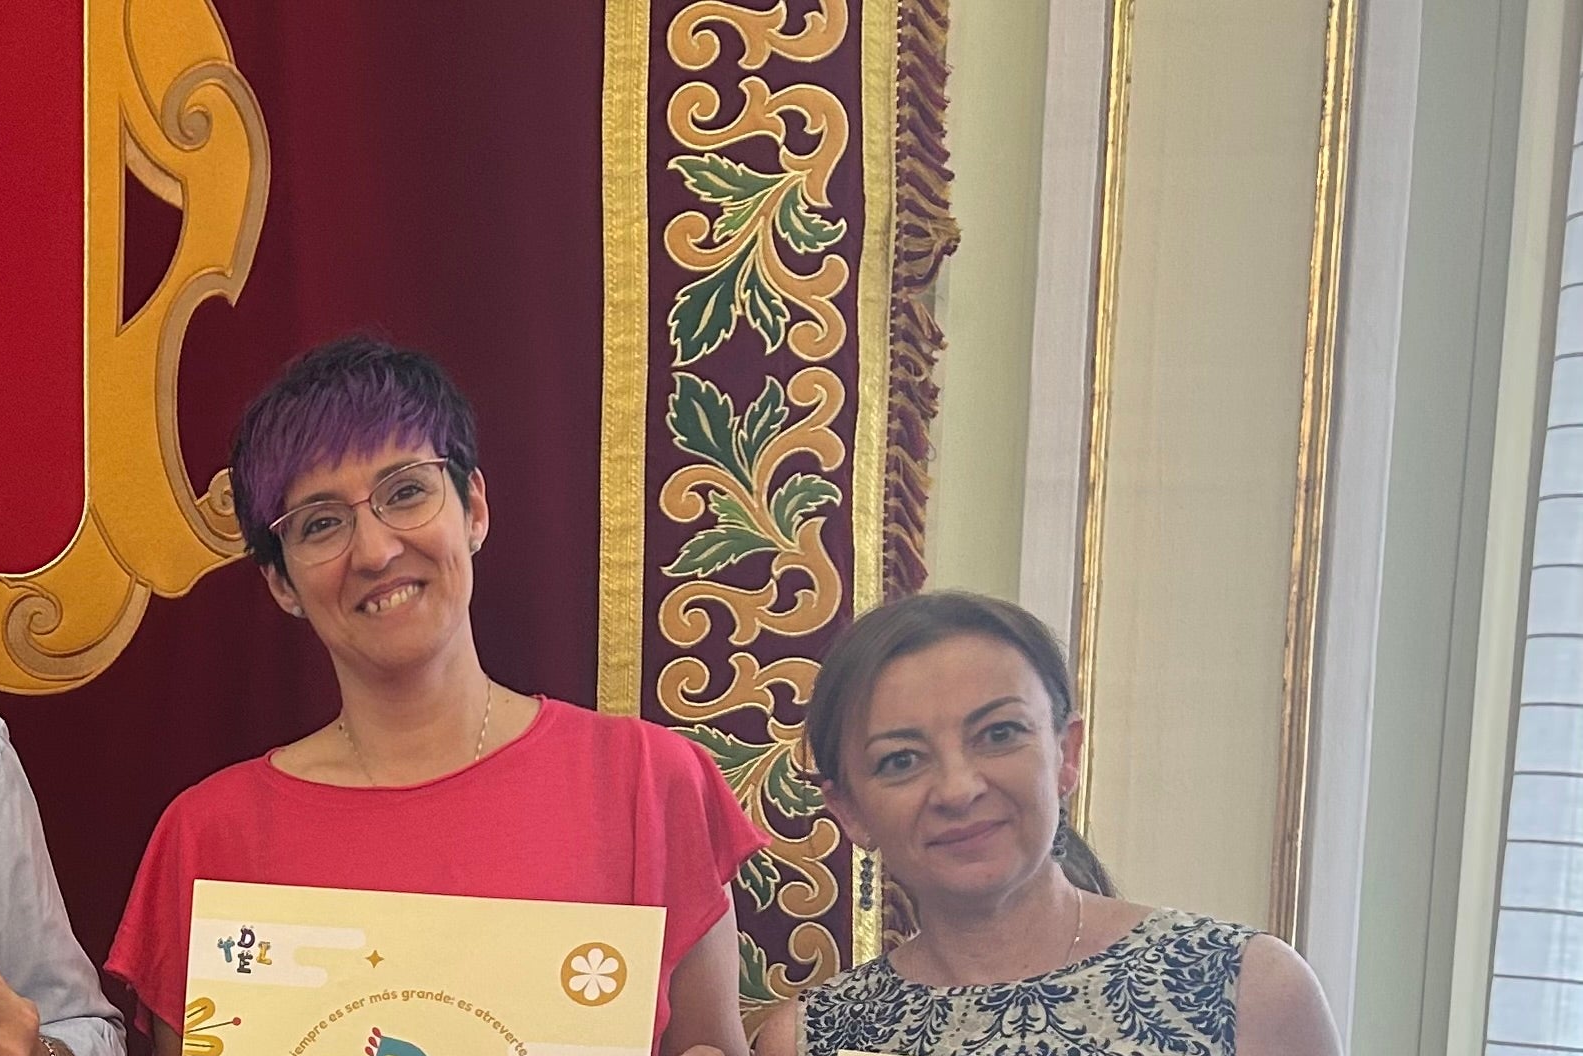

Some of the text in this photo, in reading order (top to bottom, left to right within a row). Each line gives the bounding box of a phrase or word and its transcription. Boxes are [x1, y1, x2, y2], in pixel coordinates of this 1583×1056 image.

[329, 1009, 344, 1022] es
[345, 998, 365, 1013] ser
[369, 989, 398, 1004] más
[457, 1000, 473, 1012] es
[475, 1009, 527, 1056] atreverte
